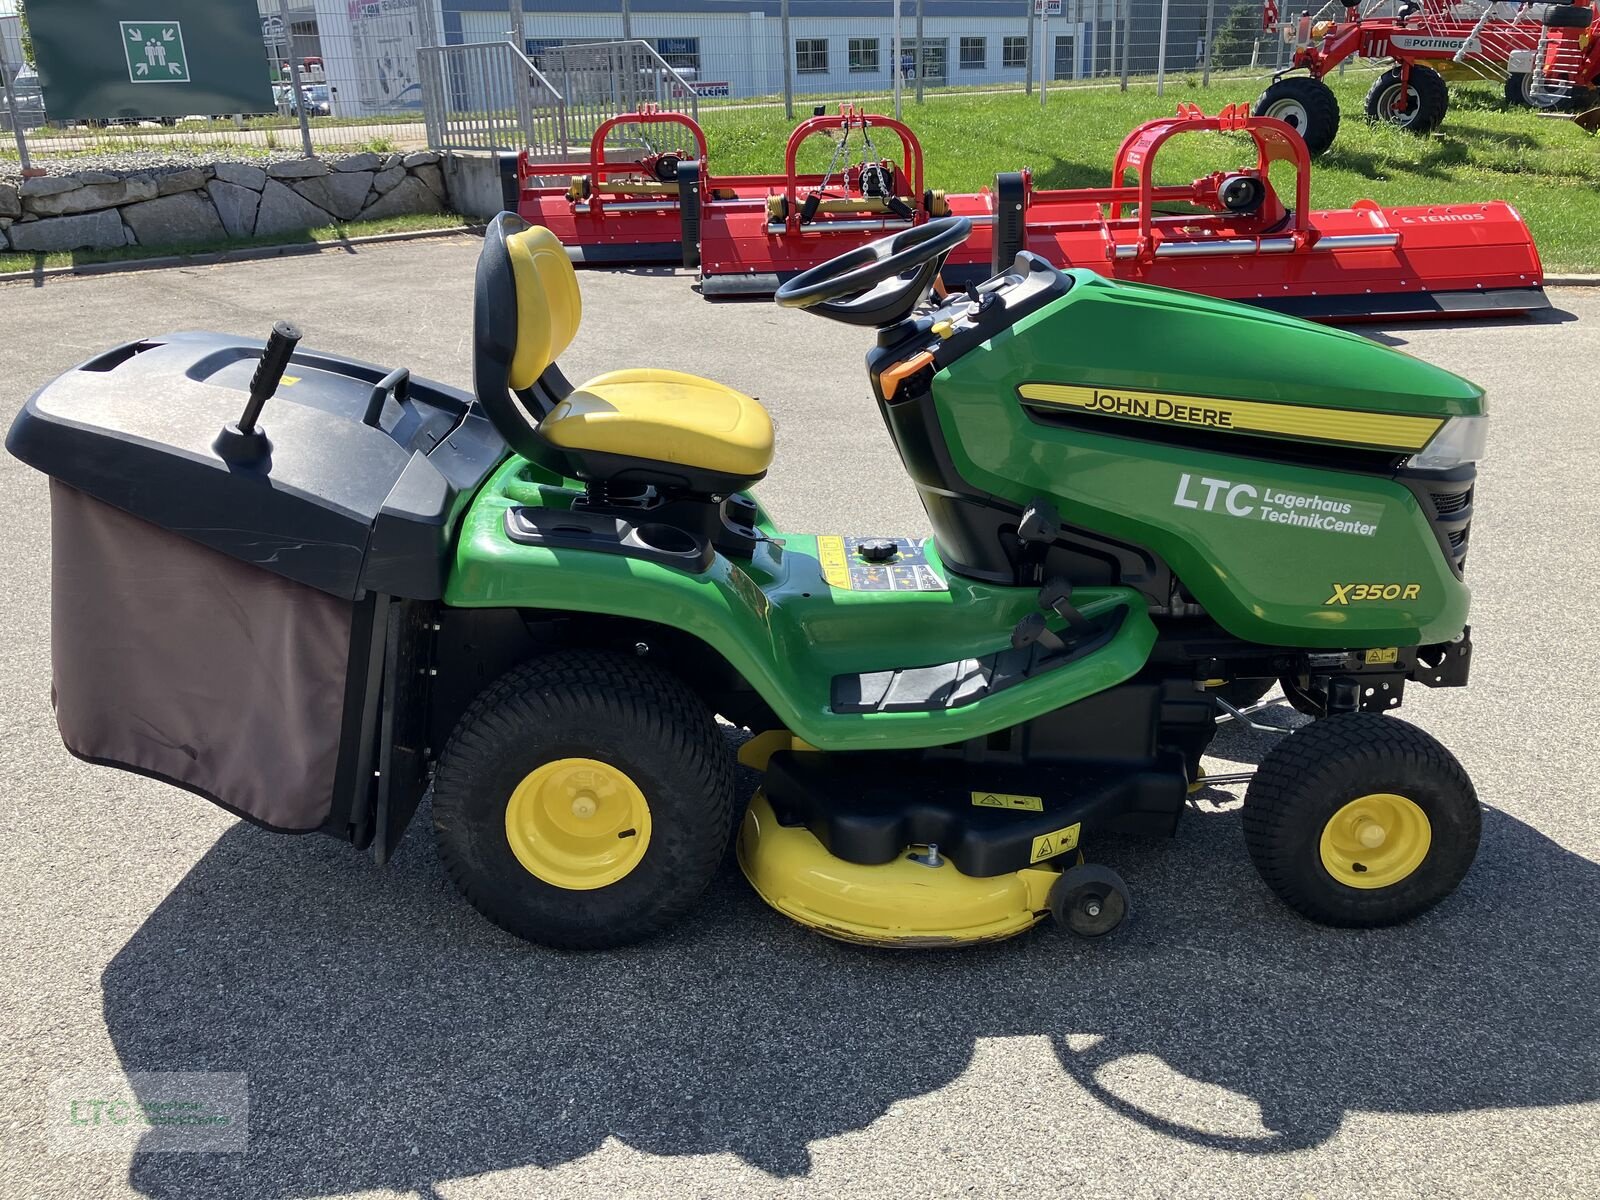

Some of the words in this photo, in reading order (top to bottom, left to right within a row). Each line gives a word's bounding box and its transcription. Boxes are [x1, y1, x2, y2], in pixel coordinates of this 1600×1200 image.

[1418, 213, 1485, 223] TEHNOS
[1084, 390, 1150, 416] JOHN
[1155, 399, 1233, 428] DEERE
[1173, 472, 1258, 517] LTC
[1263, 488, 1352, 515] Lagerhaus
[1260, 506, 1377, 536] TechnikCenter
